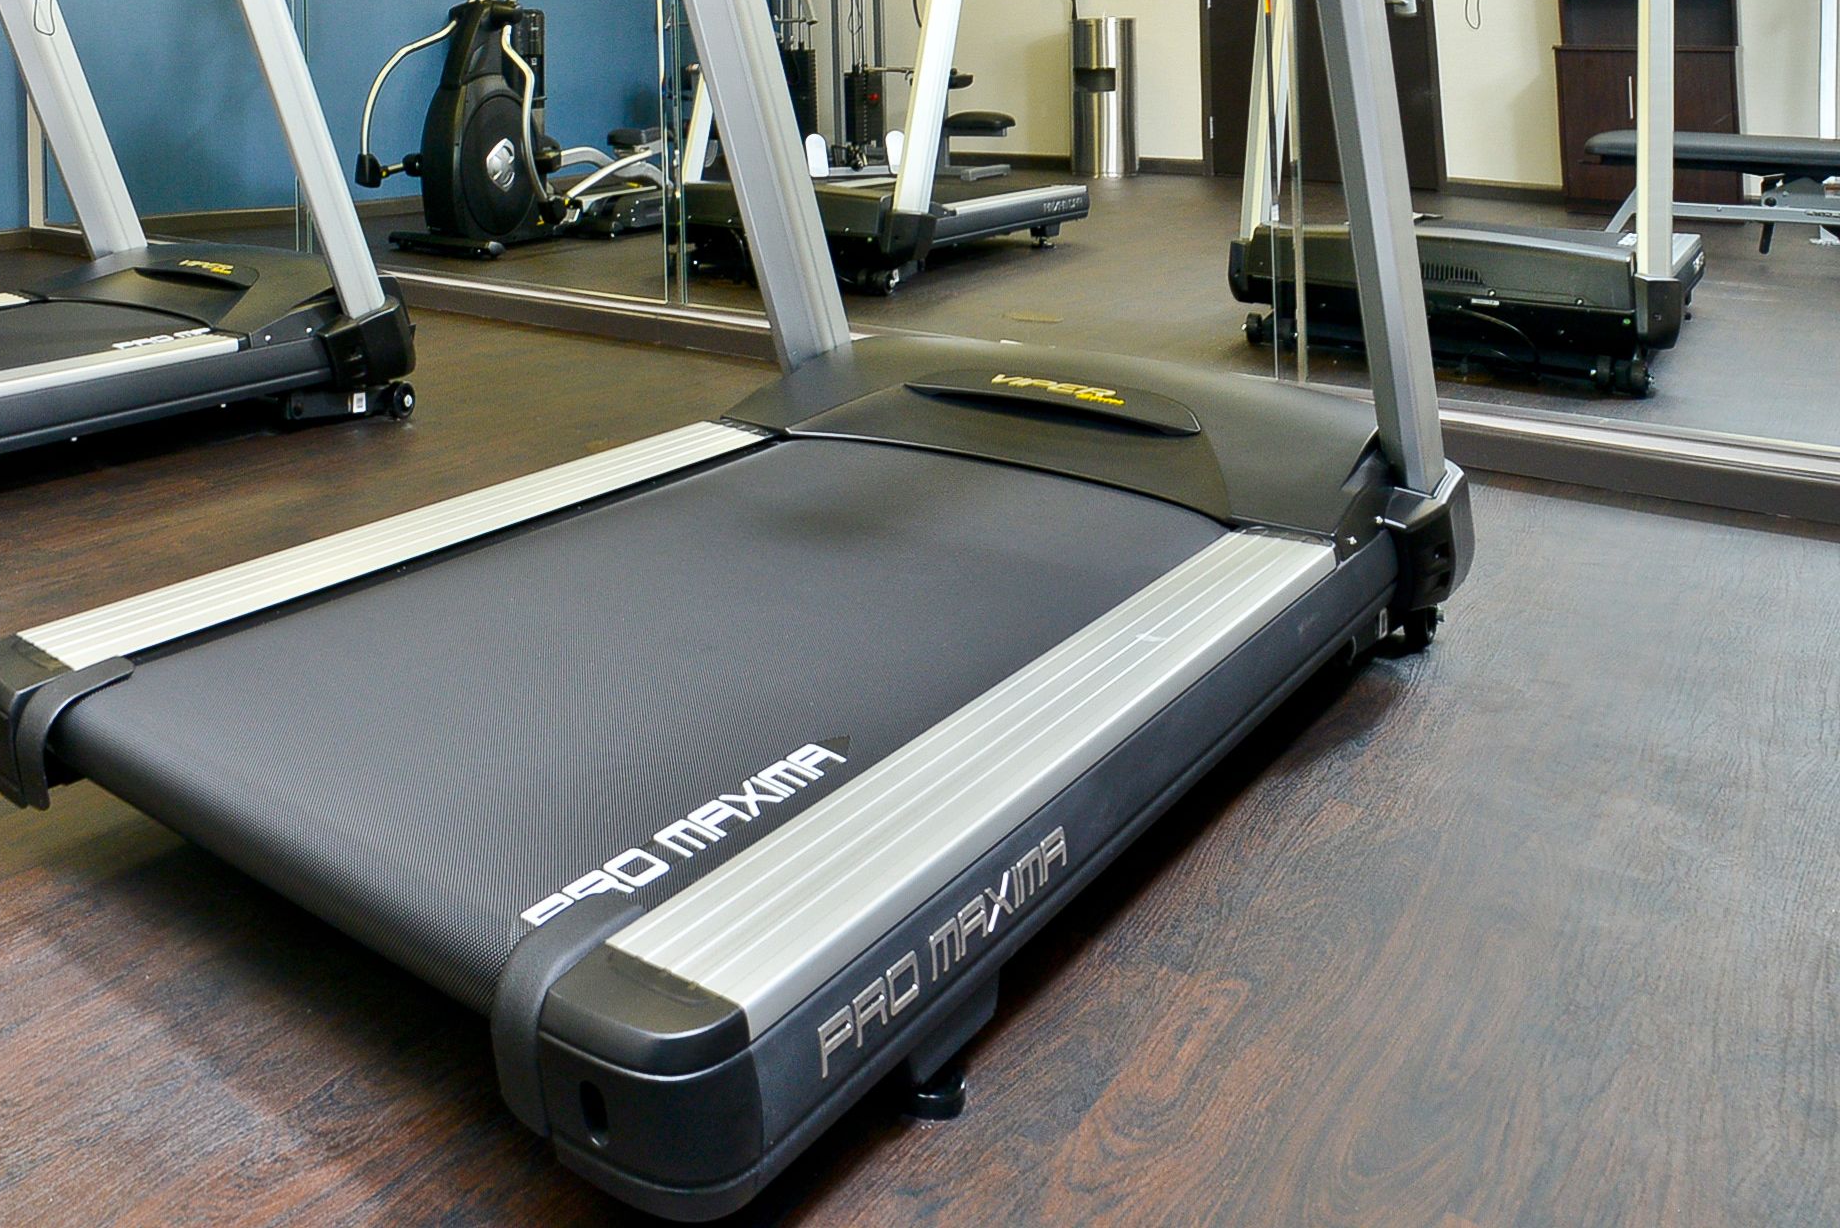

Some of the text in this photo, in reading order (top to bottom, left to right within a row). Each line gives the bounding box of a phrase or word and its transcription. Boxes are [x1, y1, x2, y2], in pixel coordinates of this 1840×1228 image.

[991, 373, 1117, 398] VIPER
[653, 743, 848, 860] MAXIMA
[817, 825, 1068, 1078] PRO MAXIMA
